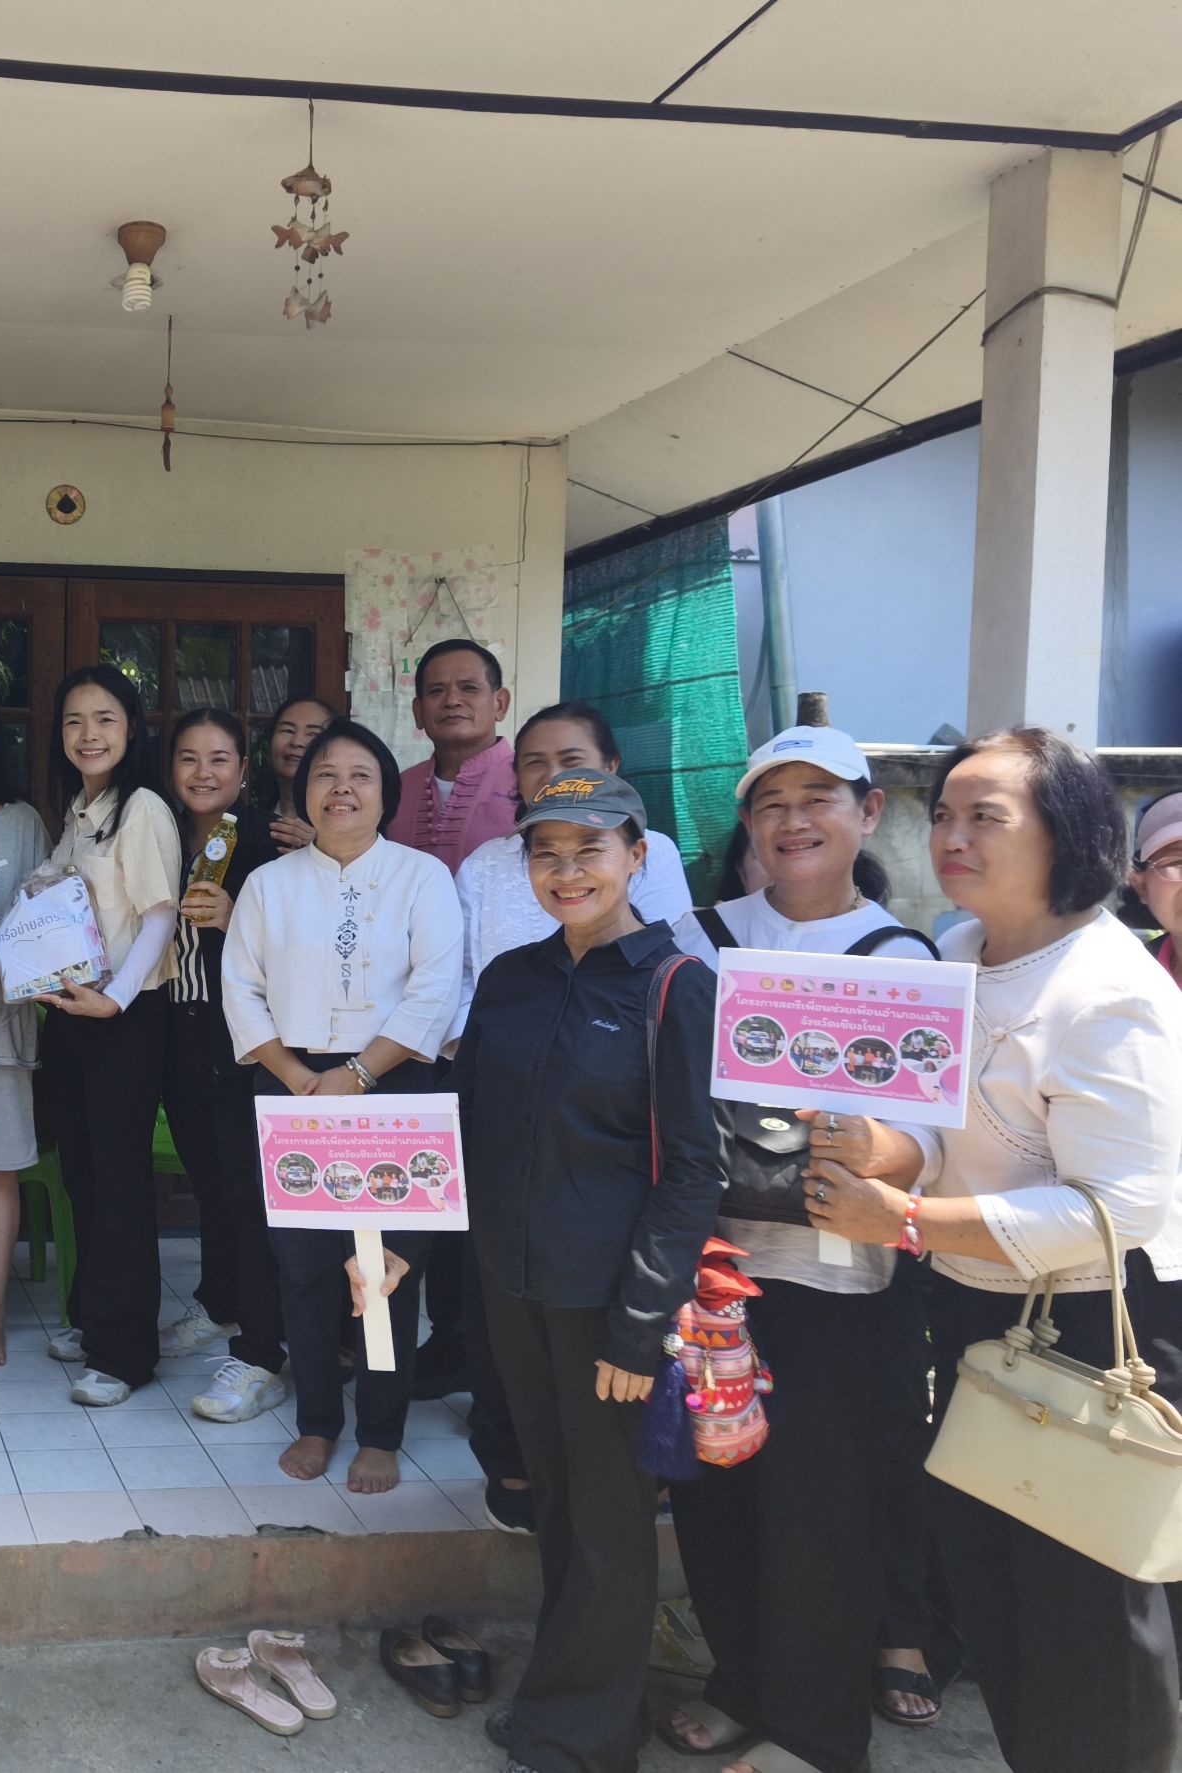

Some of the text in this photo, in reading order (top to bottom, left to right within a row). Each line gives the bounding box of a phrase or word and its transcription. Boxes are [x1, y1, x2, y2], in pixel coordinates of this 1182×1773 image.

[801, 1016, 886, 1033] จังหวัดเชียงใหม่
